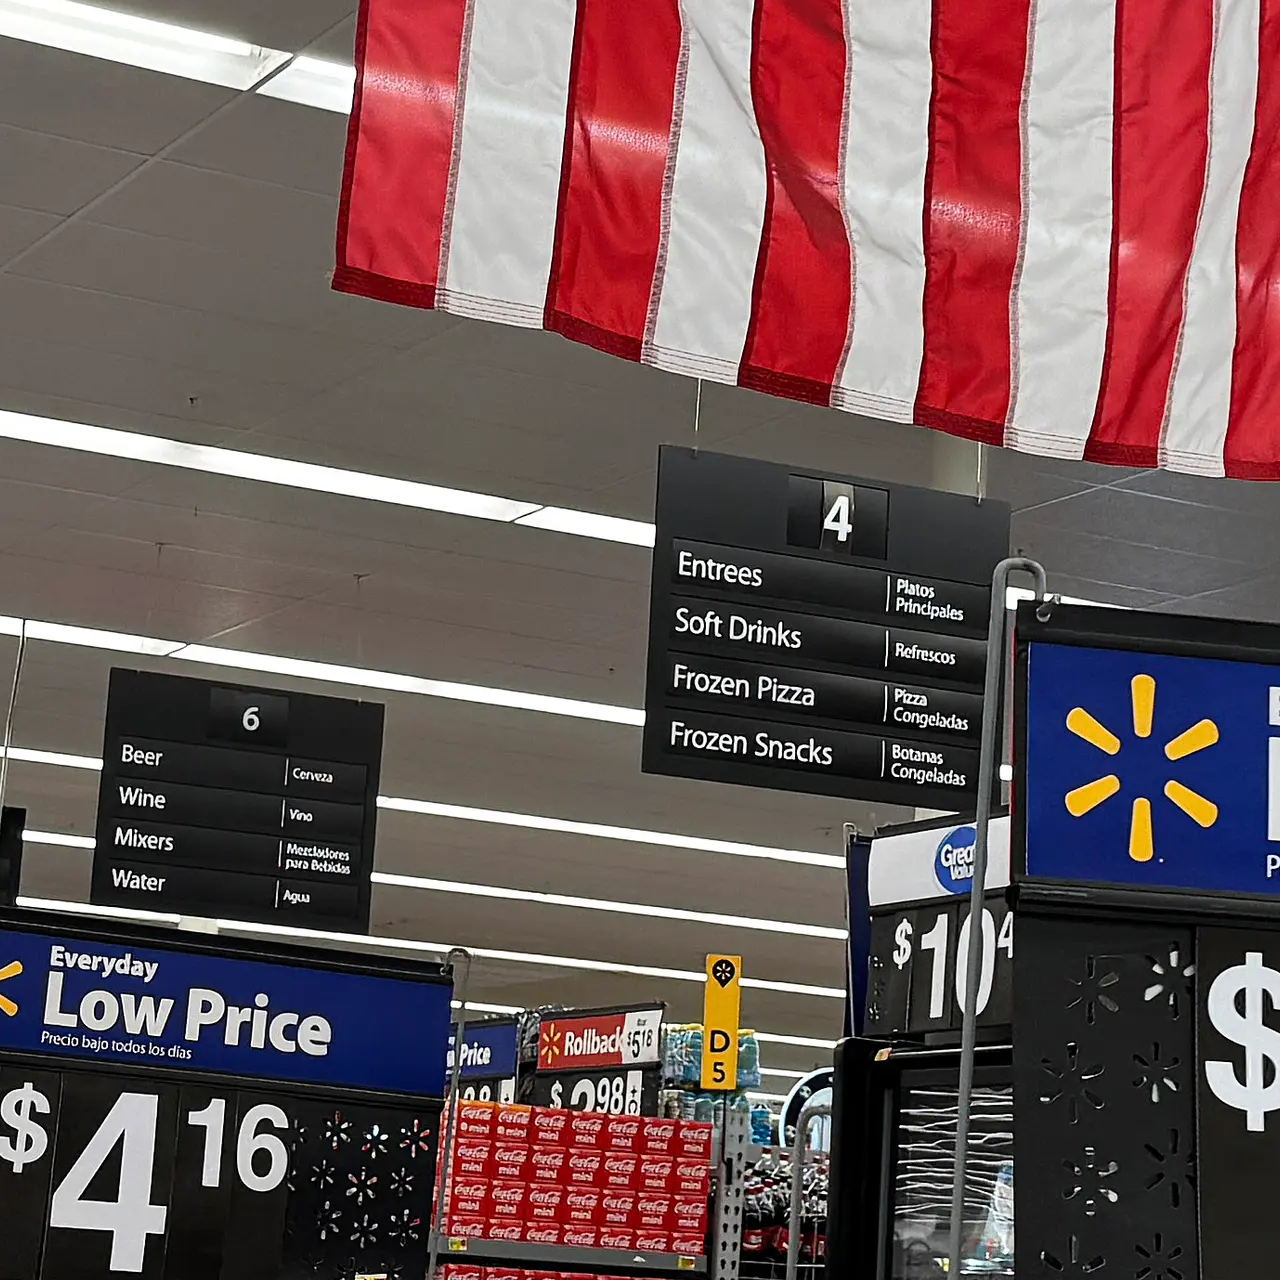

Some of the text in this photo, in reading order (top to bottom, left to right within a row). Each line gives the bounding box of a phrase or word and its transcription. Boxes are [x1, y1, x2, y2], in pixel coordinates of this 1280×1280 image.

[823, 495, 853, 542] 4
[678, 550, 763, 588] Entrees
[896, 578, 935, 598] Platos
[895, 597, 964, 622] Principales
[675, 607, 802, 649] Soft Drinks
[895, 642, 956, 665] Refrescos
[673, 664, 815, 707] Frozen Pizza
[894, 688, 928, 707] Pizza
[242, 706, 260, 731] 6
[893, 706, 969, 731] Congeladas
[121, 744, 163, 767] Beer
[670, 721, 833, 766] Frozen Snacks
[891, 745, 944, 765] Botanas
[292, 767, 334, 784] Cerveza
[890, 763, 966, 788] Congeladas
[119, 786, 166, 809] Wine
[289, 808, 313, 822] Vino
[114, 826, 174, 851] Mixers
[285, 858, 351, 875] para Bebidas
[111, 868, 166, 892] Water
[282, 888, 311, 904] Agua
[49, 944, 159, 983] Everyday
[43, 970, 332, 1056] Low Price
[40, 1030, 79, 1047] Precio
[81, 1034, 109, 1053] bajo
[111, 1039, 146, 1055] todos
[148, 1042, 166, 1057] los
[459, 1041, 491, 1067] Price
[710, 1031, 730, 1053] D
[713, 1061, 726, 1083] 5
